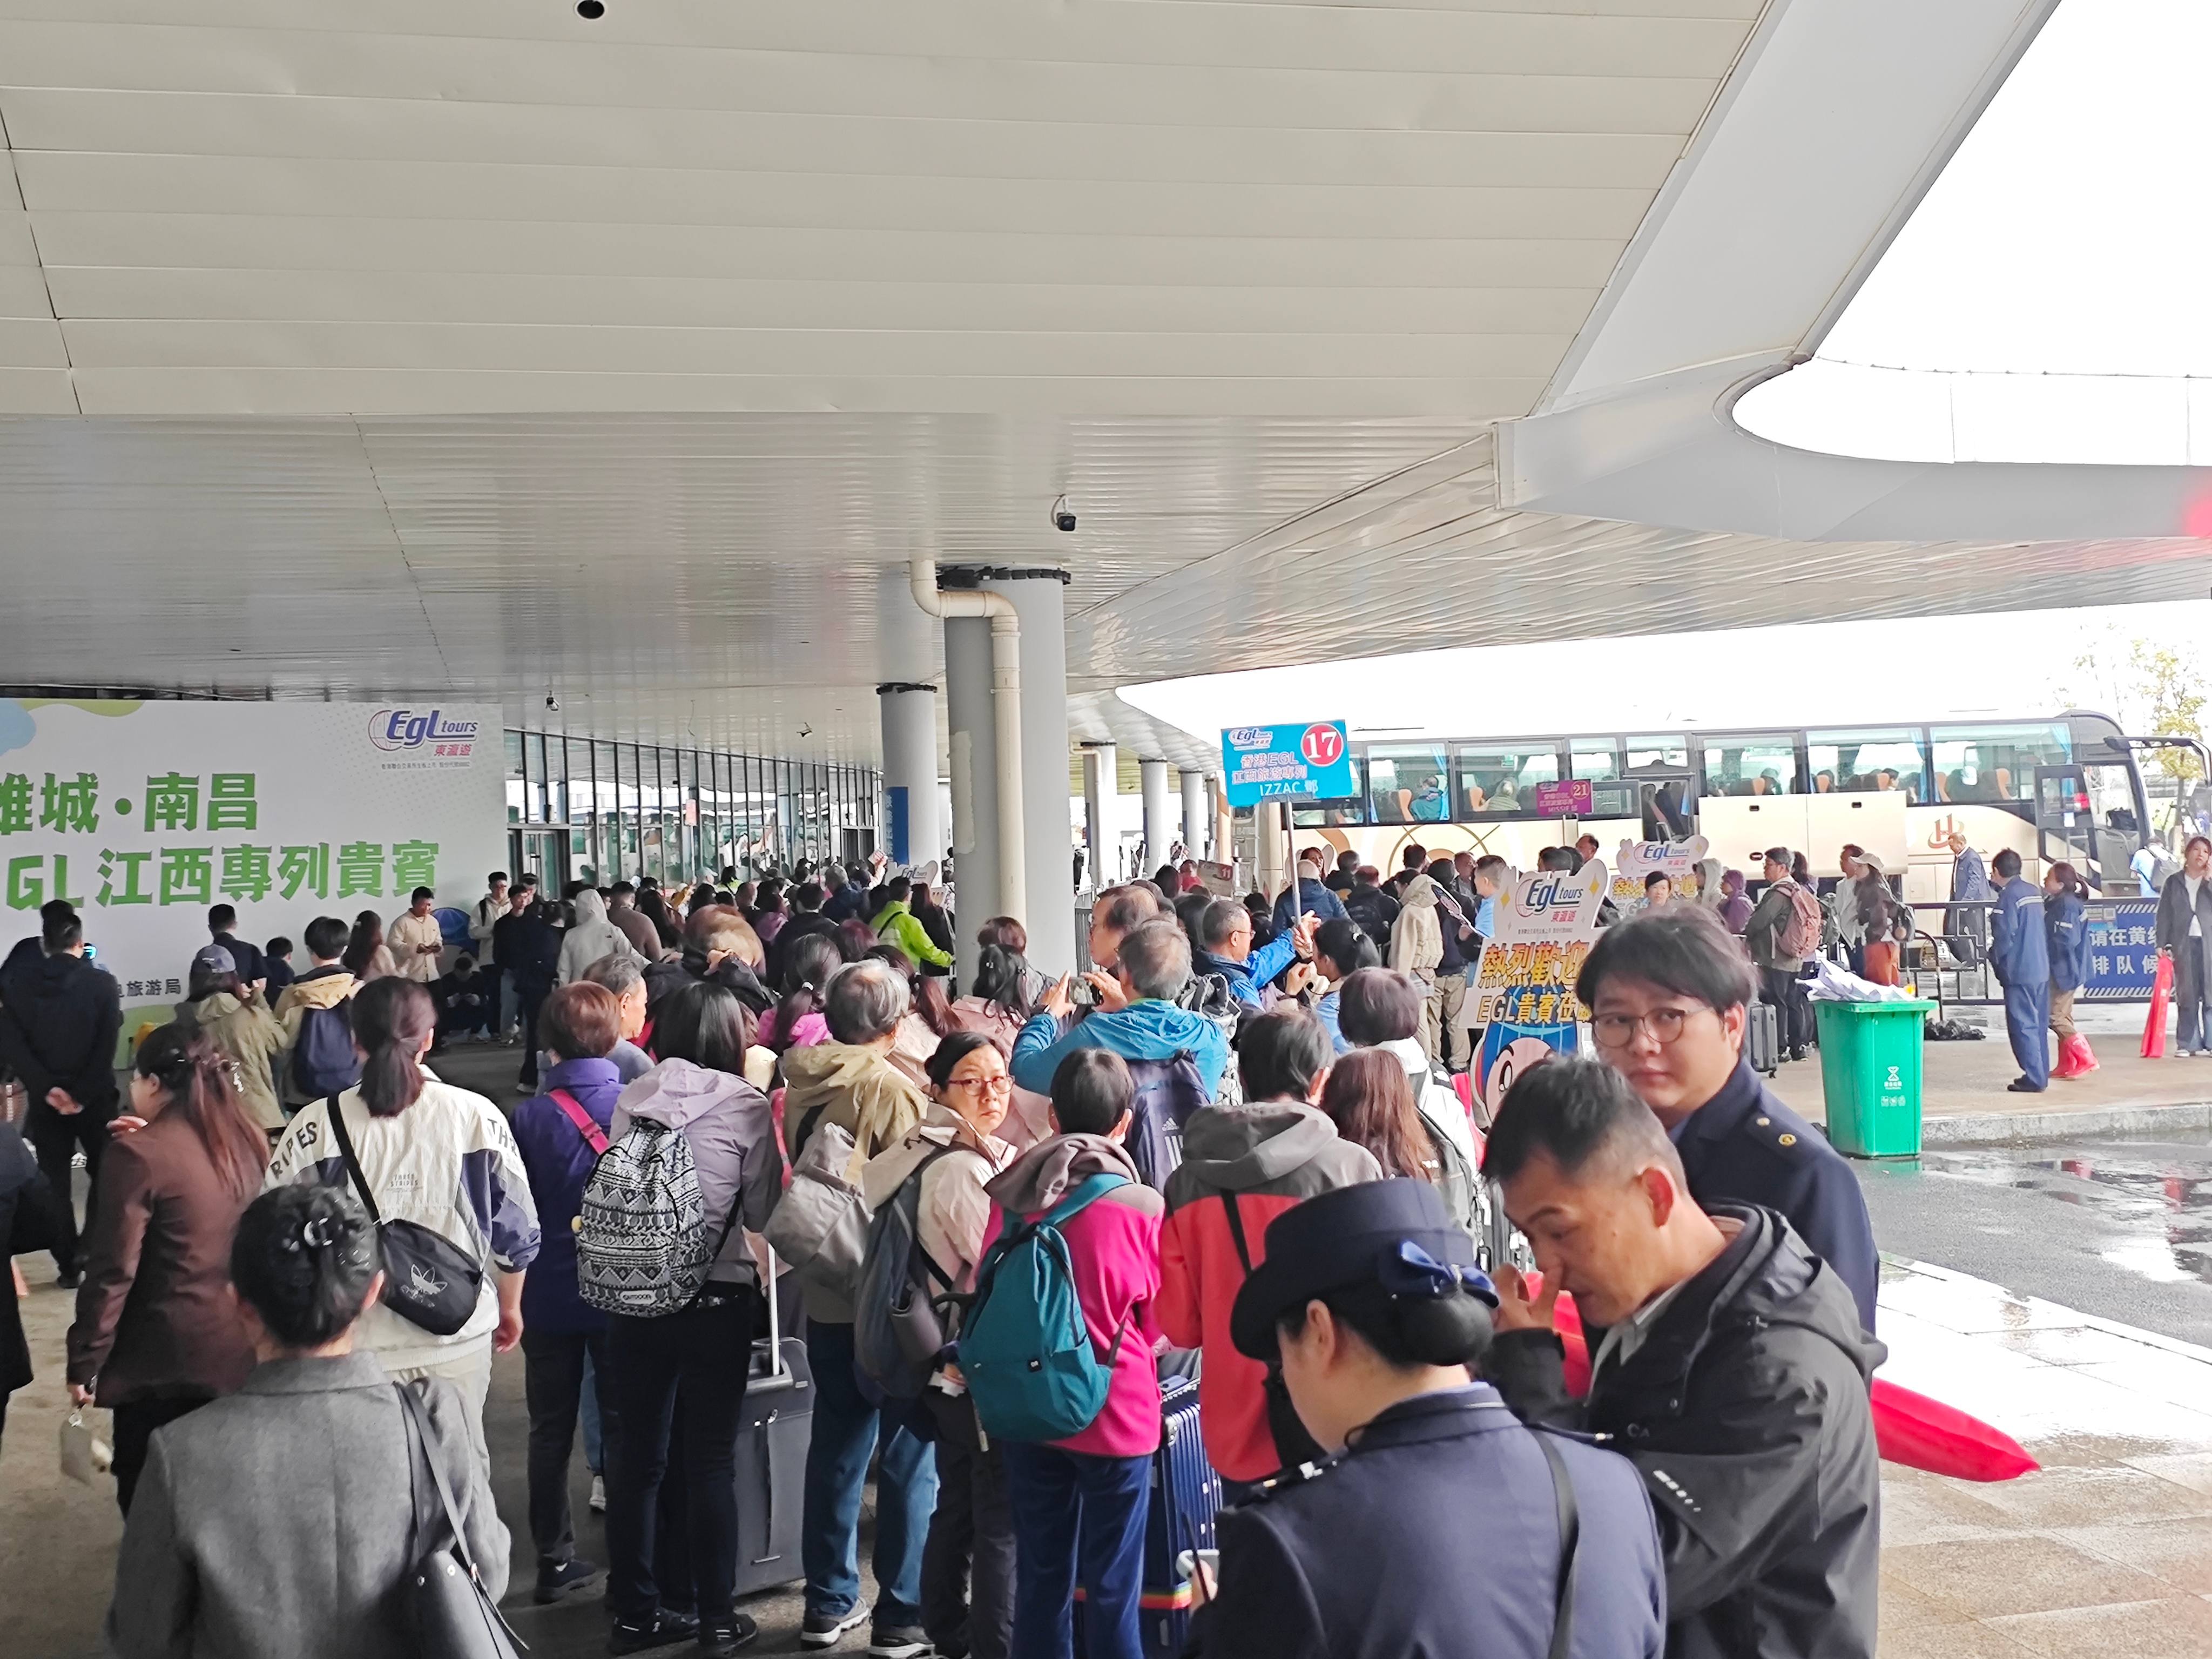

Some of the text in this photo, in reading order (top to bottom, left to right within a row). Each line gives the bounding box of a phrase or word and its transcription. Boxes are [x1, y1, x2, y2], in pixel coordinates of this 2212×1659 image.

[441, 720, 478, 732] tours
[1306, 731, 1337, 758] 17
[1573, 784, 1587, 796] 21
[1222, 867, 1231, 879] 11
[1559, 887, 1583, 899] tours
